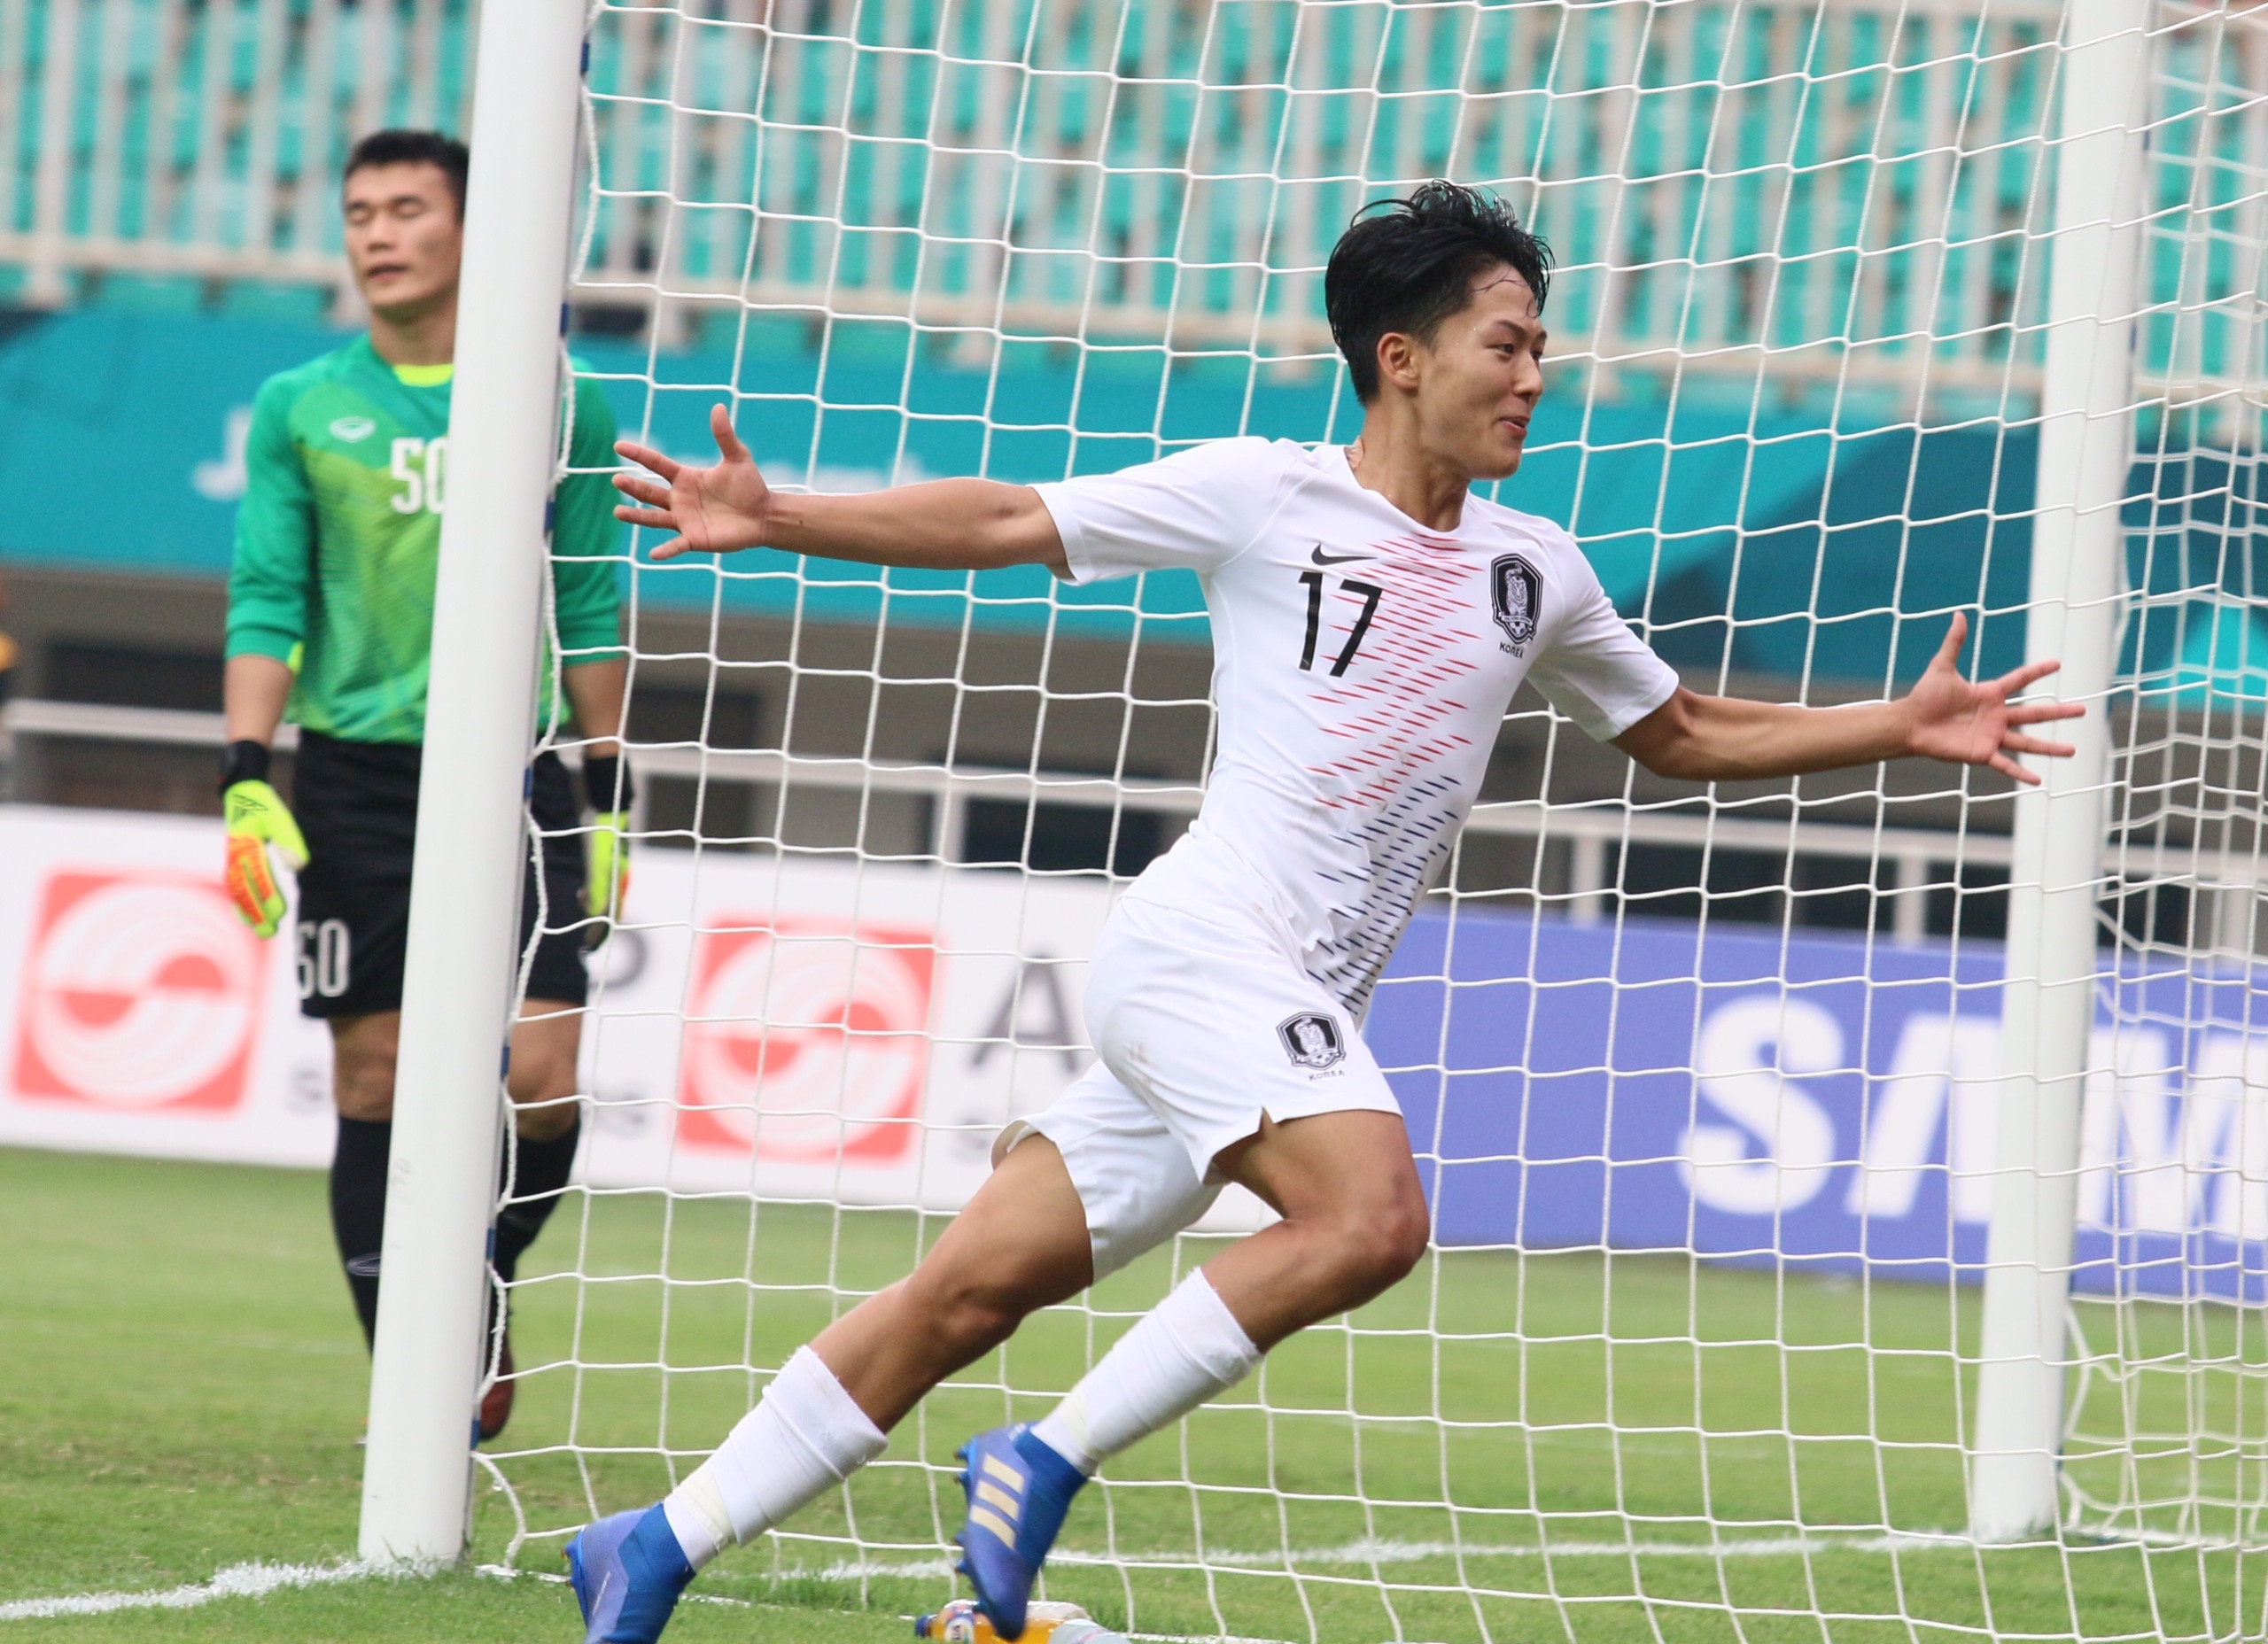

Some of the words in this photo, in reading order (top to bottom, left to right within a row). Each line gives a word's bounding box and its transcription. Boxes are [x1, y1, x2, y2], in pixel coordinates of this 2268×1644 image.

[1298, 570, 1383, 678] 17
[1499, 641, 1524, 659] KOREA
[297, 918, 351, 1000] 50
[1309, 1069, 1347, 1082] KOREA
